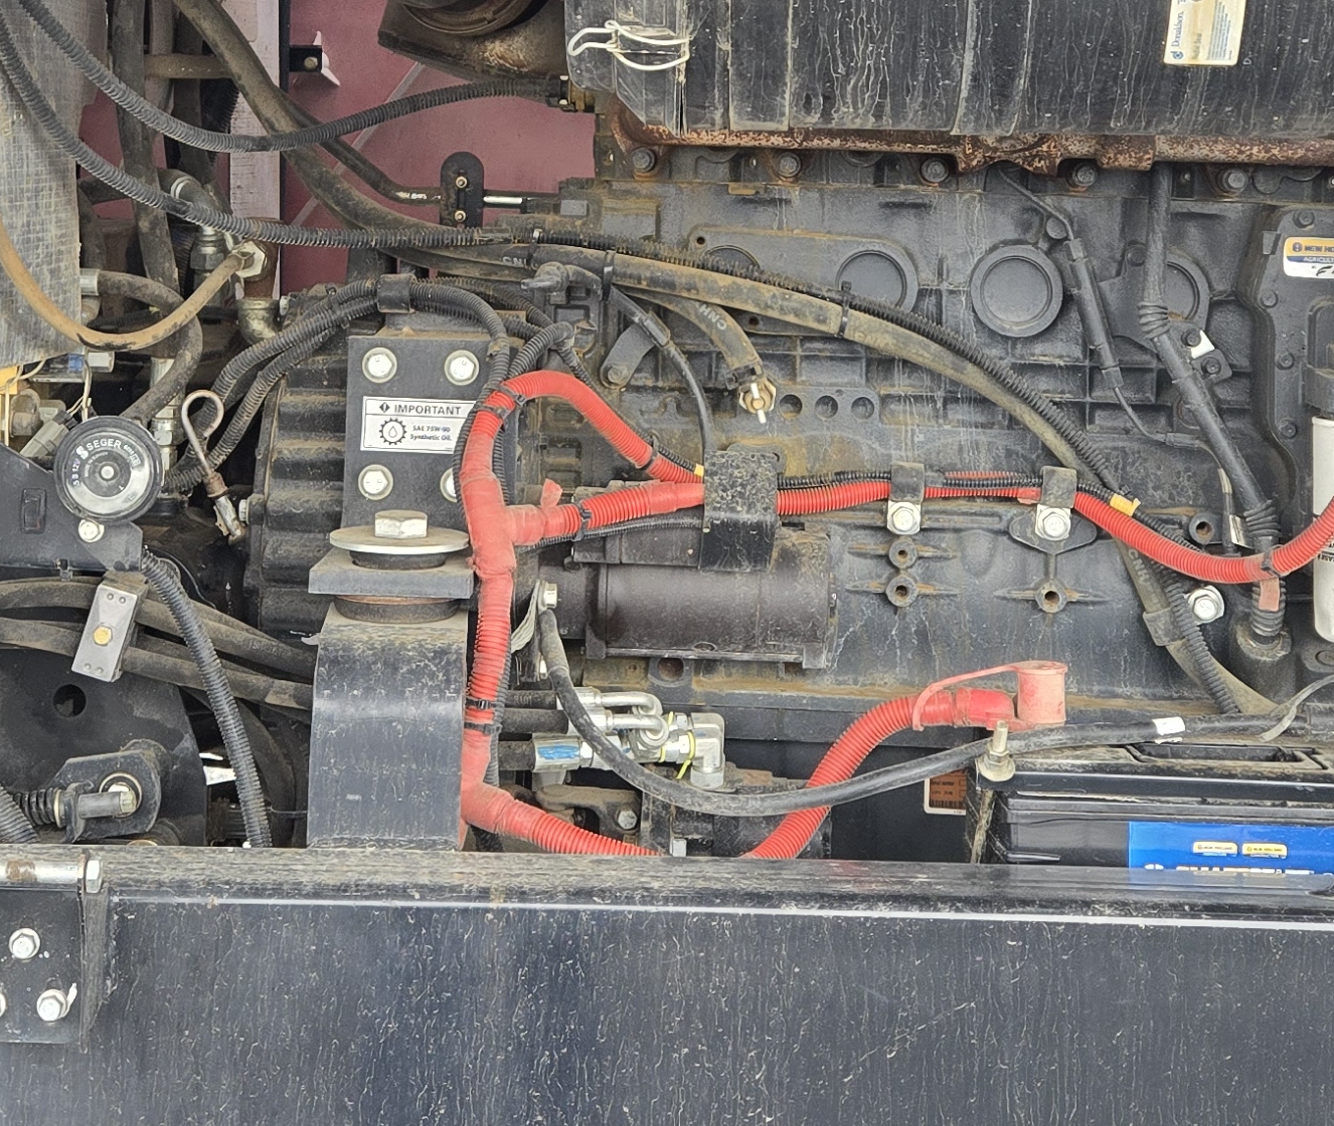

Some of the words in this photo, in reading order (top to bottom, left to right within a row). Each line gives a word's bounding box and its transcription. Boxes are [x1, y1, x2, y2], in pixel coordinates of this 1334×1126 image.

[394, 404, 462, 416] IMPORTANT
[412, 424, 425, 433] SAE
[410, 433, 439, 442] Synthetic
[86, 438, 122, 451] SEGER
